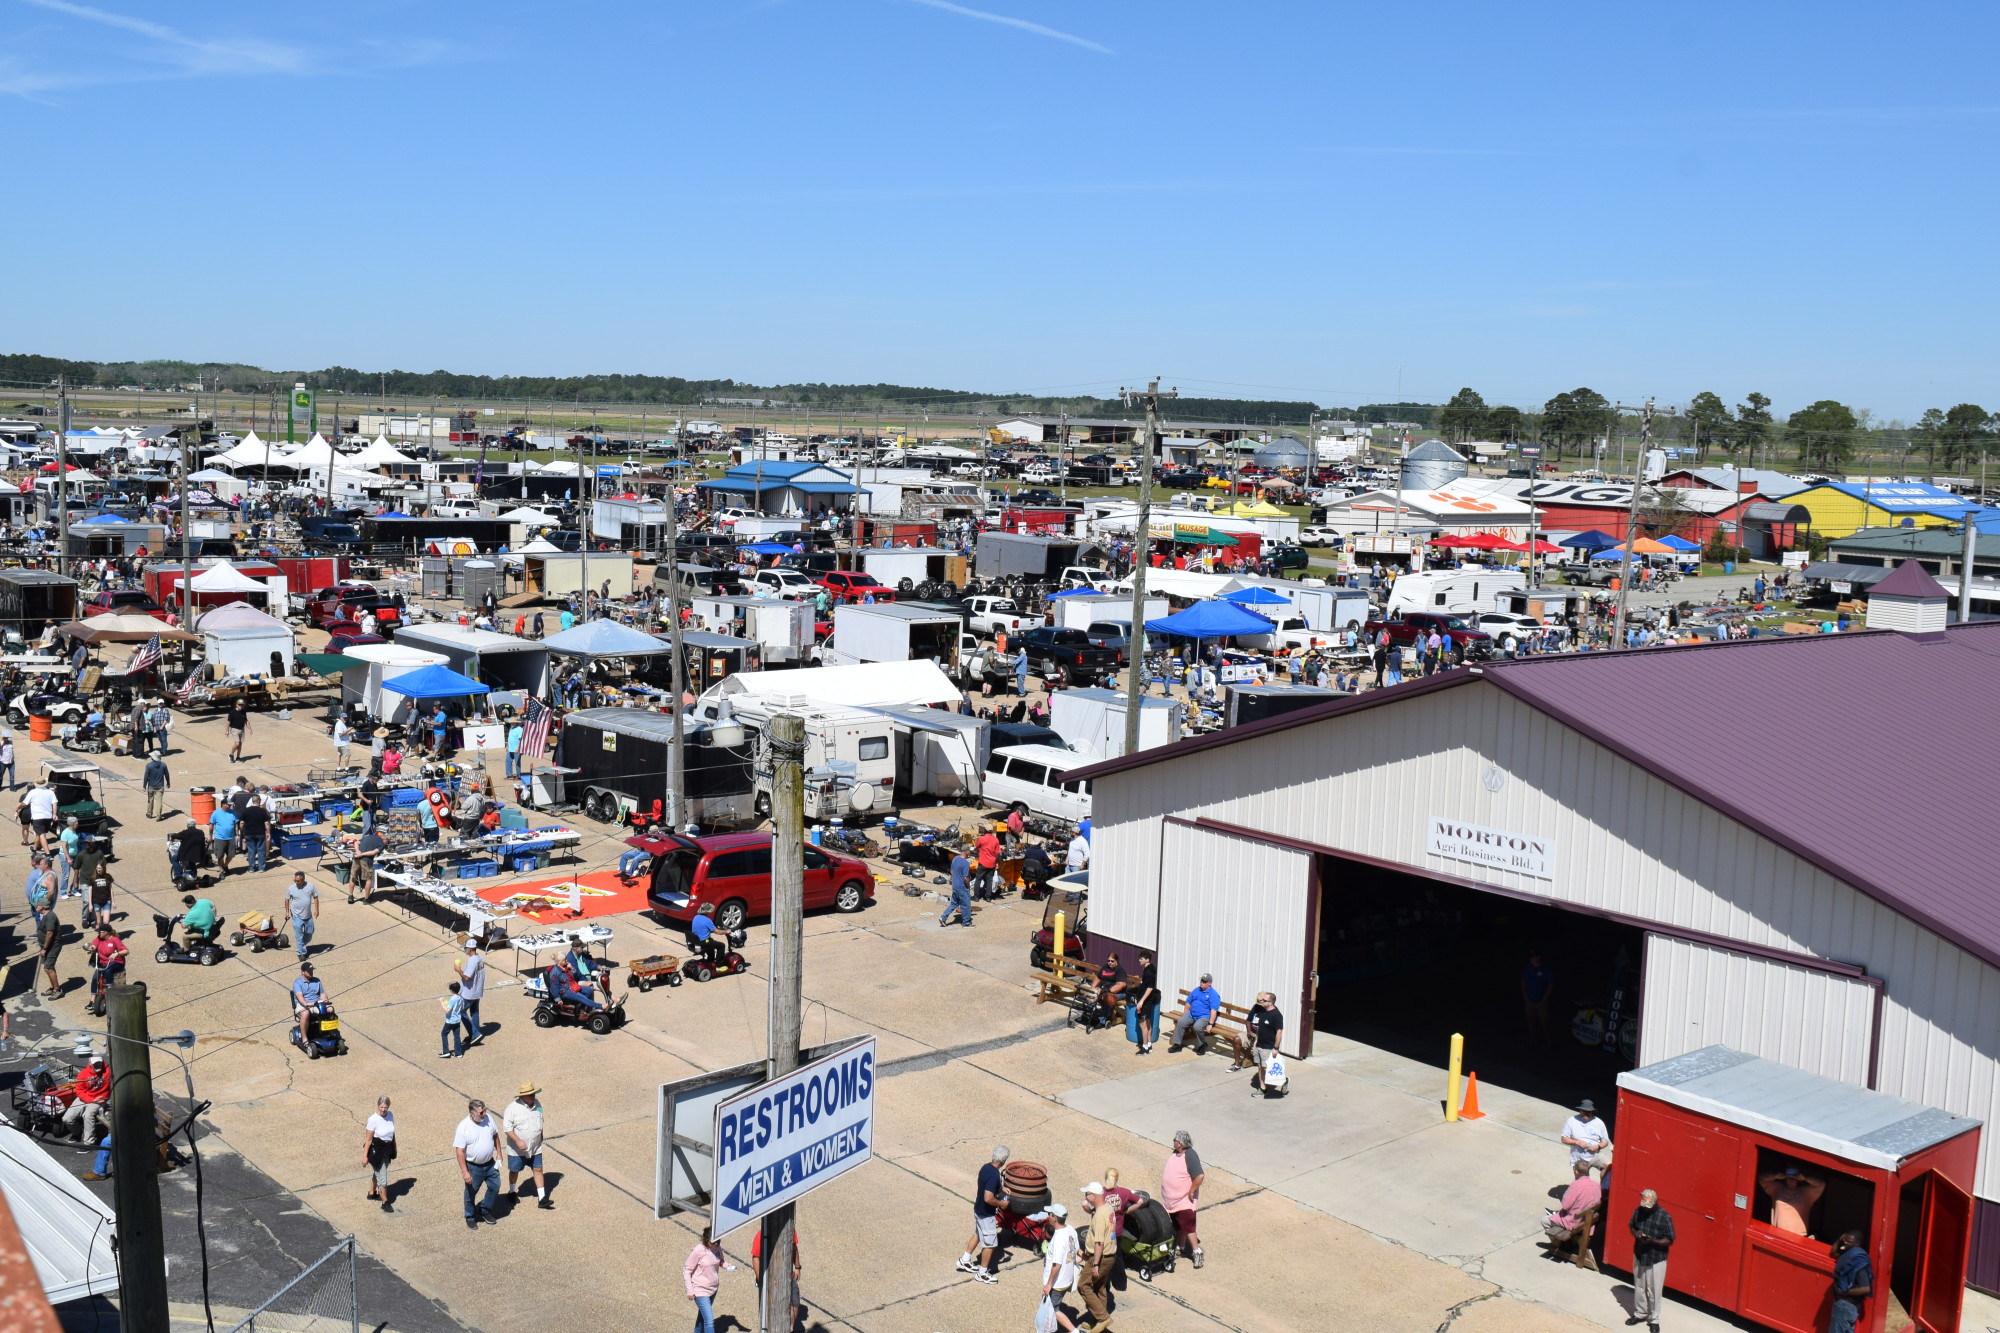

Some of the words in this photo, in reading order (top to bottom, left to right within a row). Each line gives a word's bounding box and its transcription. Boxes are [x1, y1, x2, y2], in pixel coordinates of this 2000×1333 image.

[1517, 483, 1637, 504] UG
[1177, 524, 1207, 533] SAUSAGE
[1457, 526, 1517, 540] CLEMSN
[1434, 839, 1456, 853] Agri
[1461, 845, 1507, 863] Business
[1511, 855, 1534, 870] Bld.
[1540, 861, 1545, 872] 1
[1435, 821, 1546, 856] MORTON
[1608, 989, 1623, 1031] HOOD
[719, 1051, 873, 1167] RESTROOMS
[738, 1166, 775, 1209] MEN
[781, 1159, 792, 1188] &
[800, 1125, 857, 1177] WOMEN
